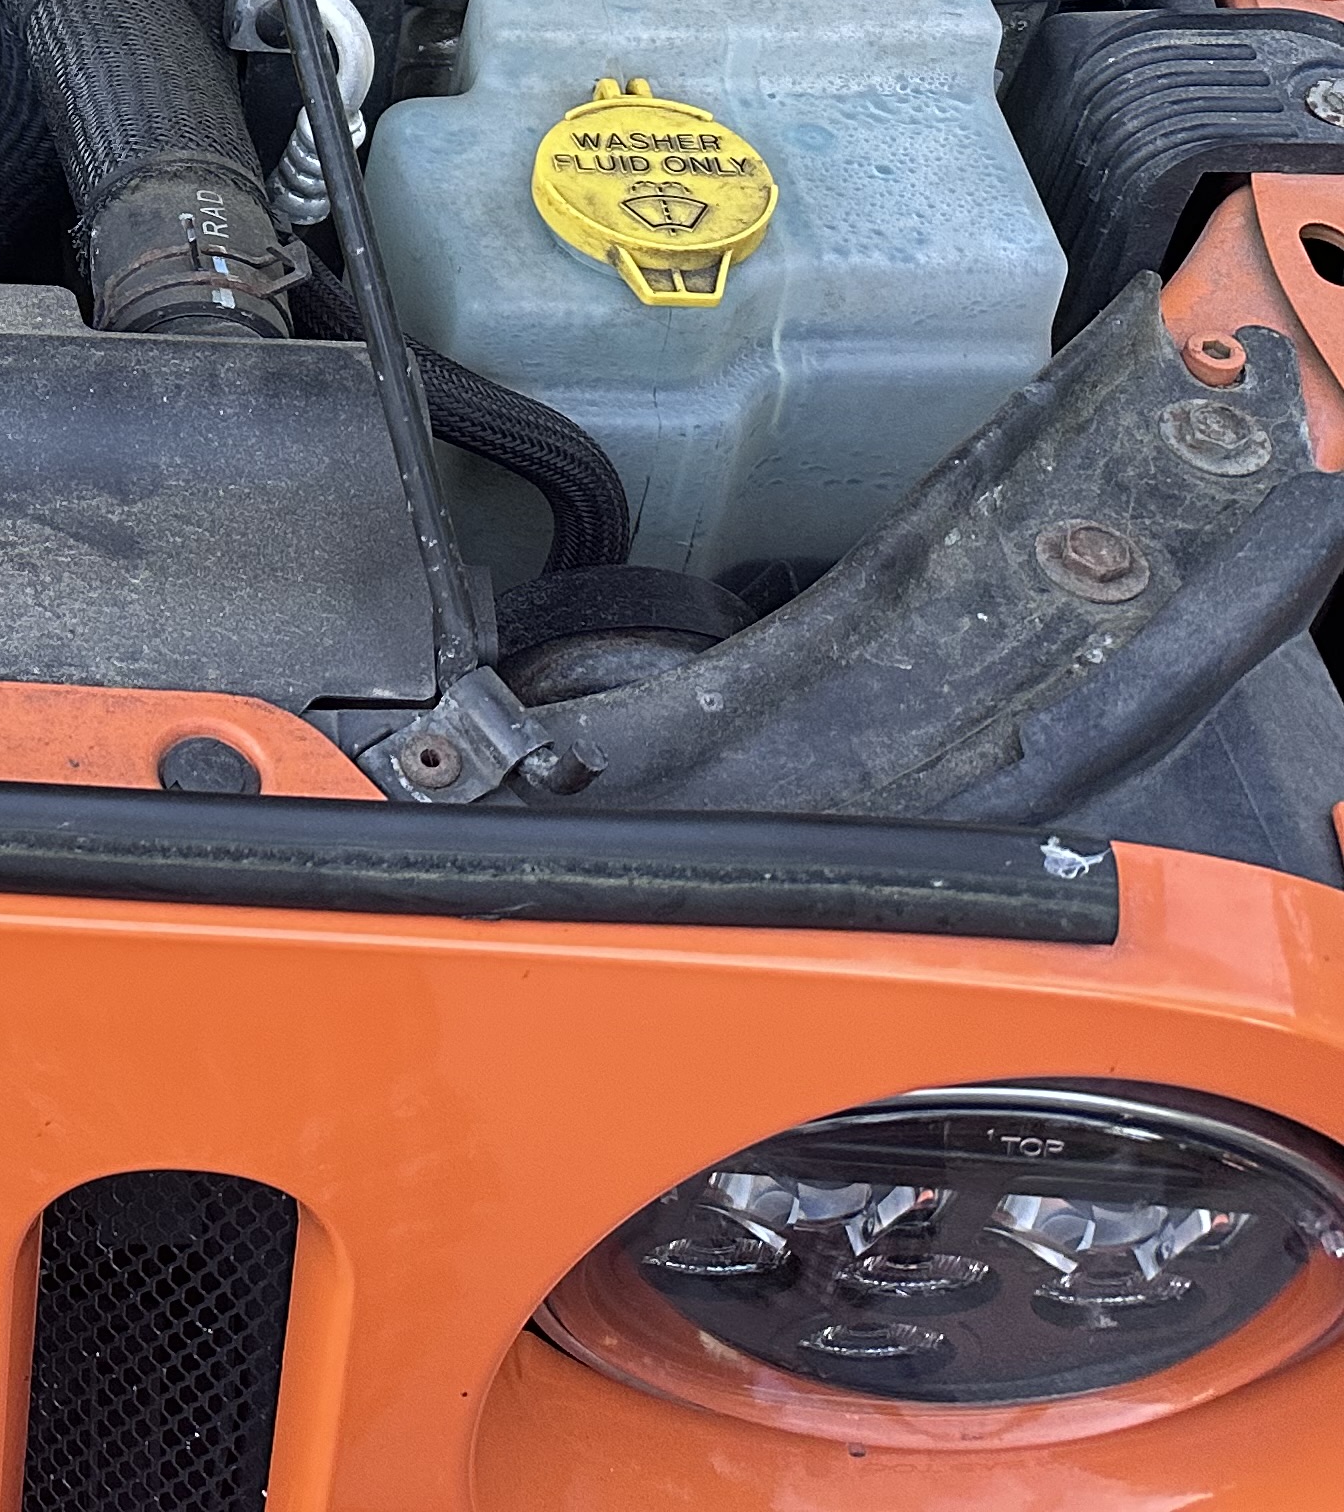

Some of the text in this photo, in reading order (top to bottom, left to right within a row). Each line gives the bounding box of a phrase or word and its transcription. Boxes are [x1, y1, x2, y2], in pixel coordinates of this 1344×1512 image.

[571, 132, 723, 153] WASHER
[552, 154, 748, 176] FLUID ONLY
[196, 189, 230, 239] RAD
[1001, 1136, 1065, 1157] TOP
